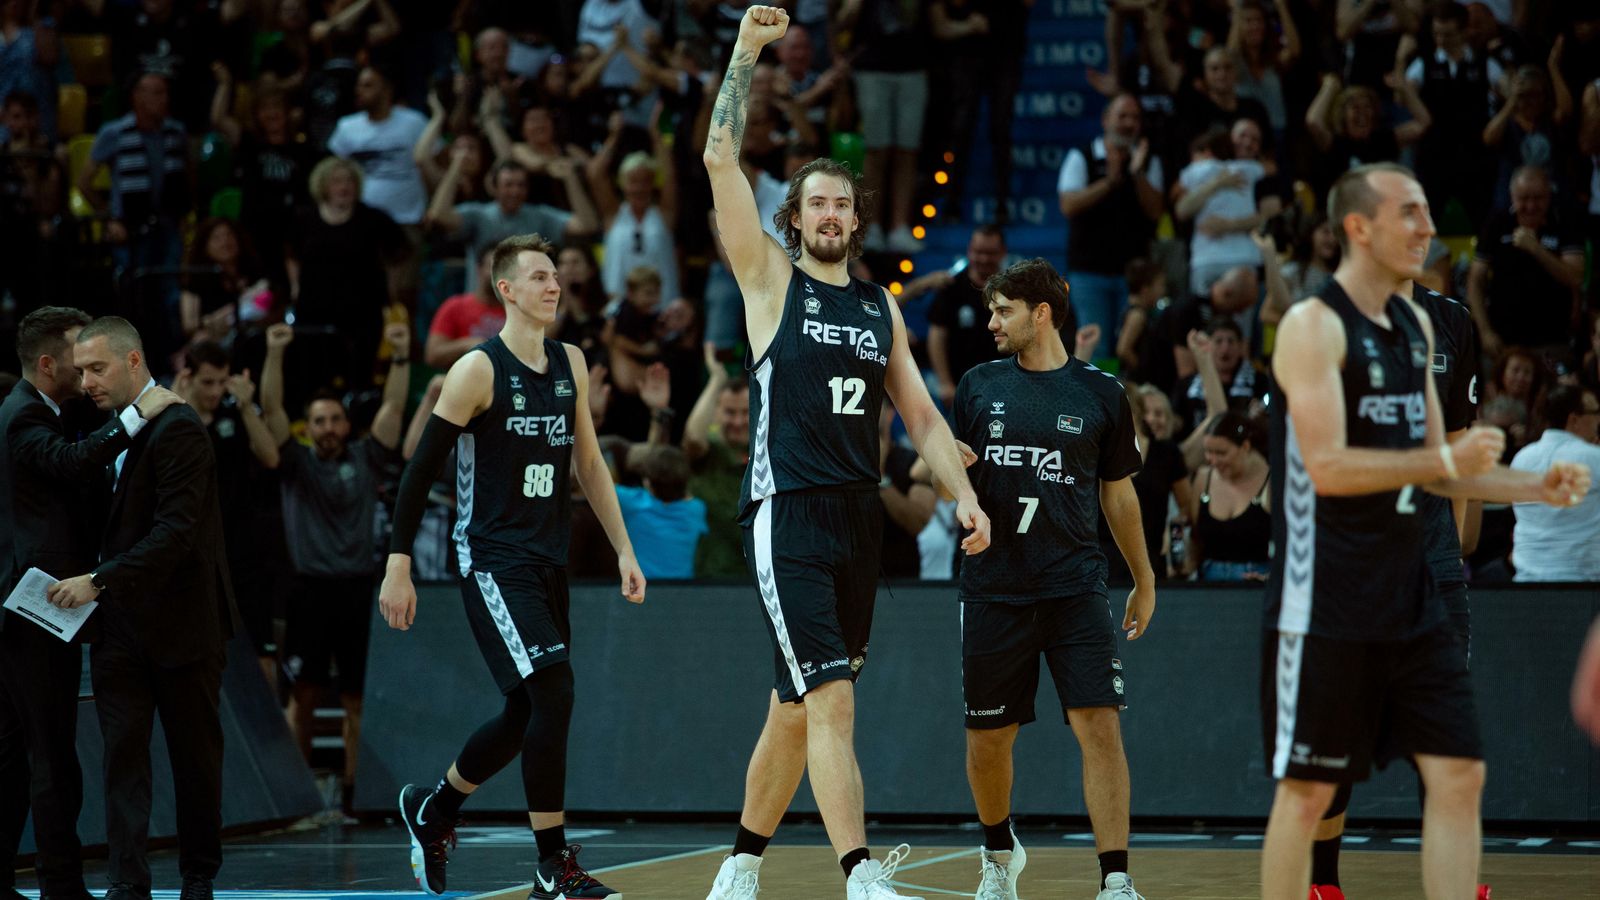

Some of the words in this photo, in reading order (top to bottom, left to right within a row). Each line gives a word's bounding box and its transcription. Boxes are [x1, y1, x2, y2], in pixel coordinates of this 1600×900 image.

[1033, 42, 1103, 66] IMQ
[1013, 91, 1084, 117] IMQ
[1010, 145, 1065, 169] MQ
[803, 318, 878, 356] RETA
[828, 376, 867, 415] 12
[506, 414, 566, 444] RETA
[984, 445, 1062, 477] RETA
[523, 463, 555, 498] 98
[1016, 497, 1039, 534] 7
[977, 708, 1004, 716] CORREO
